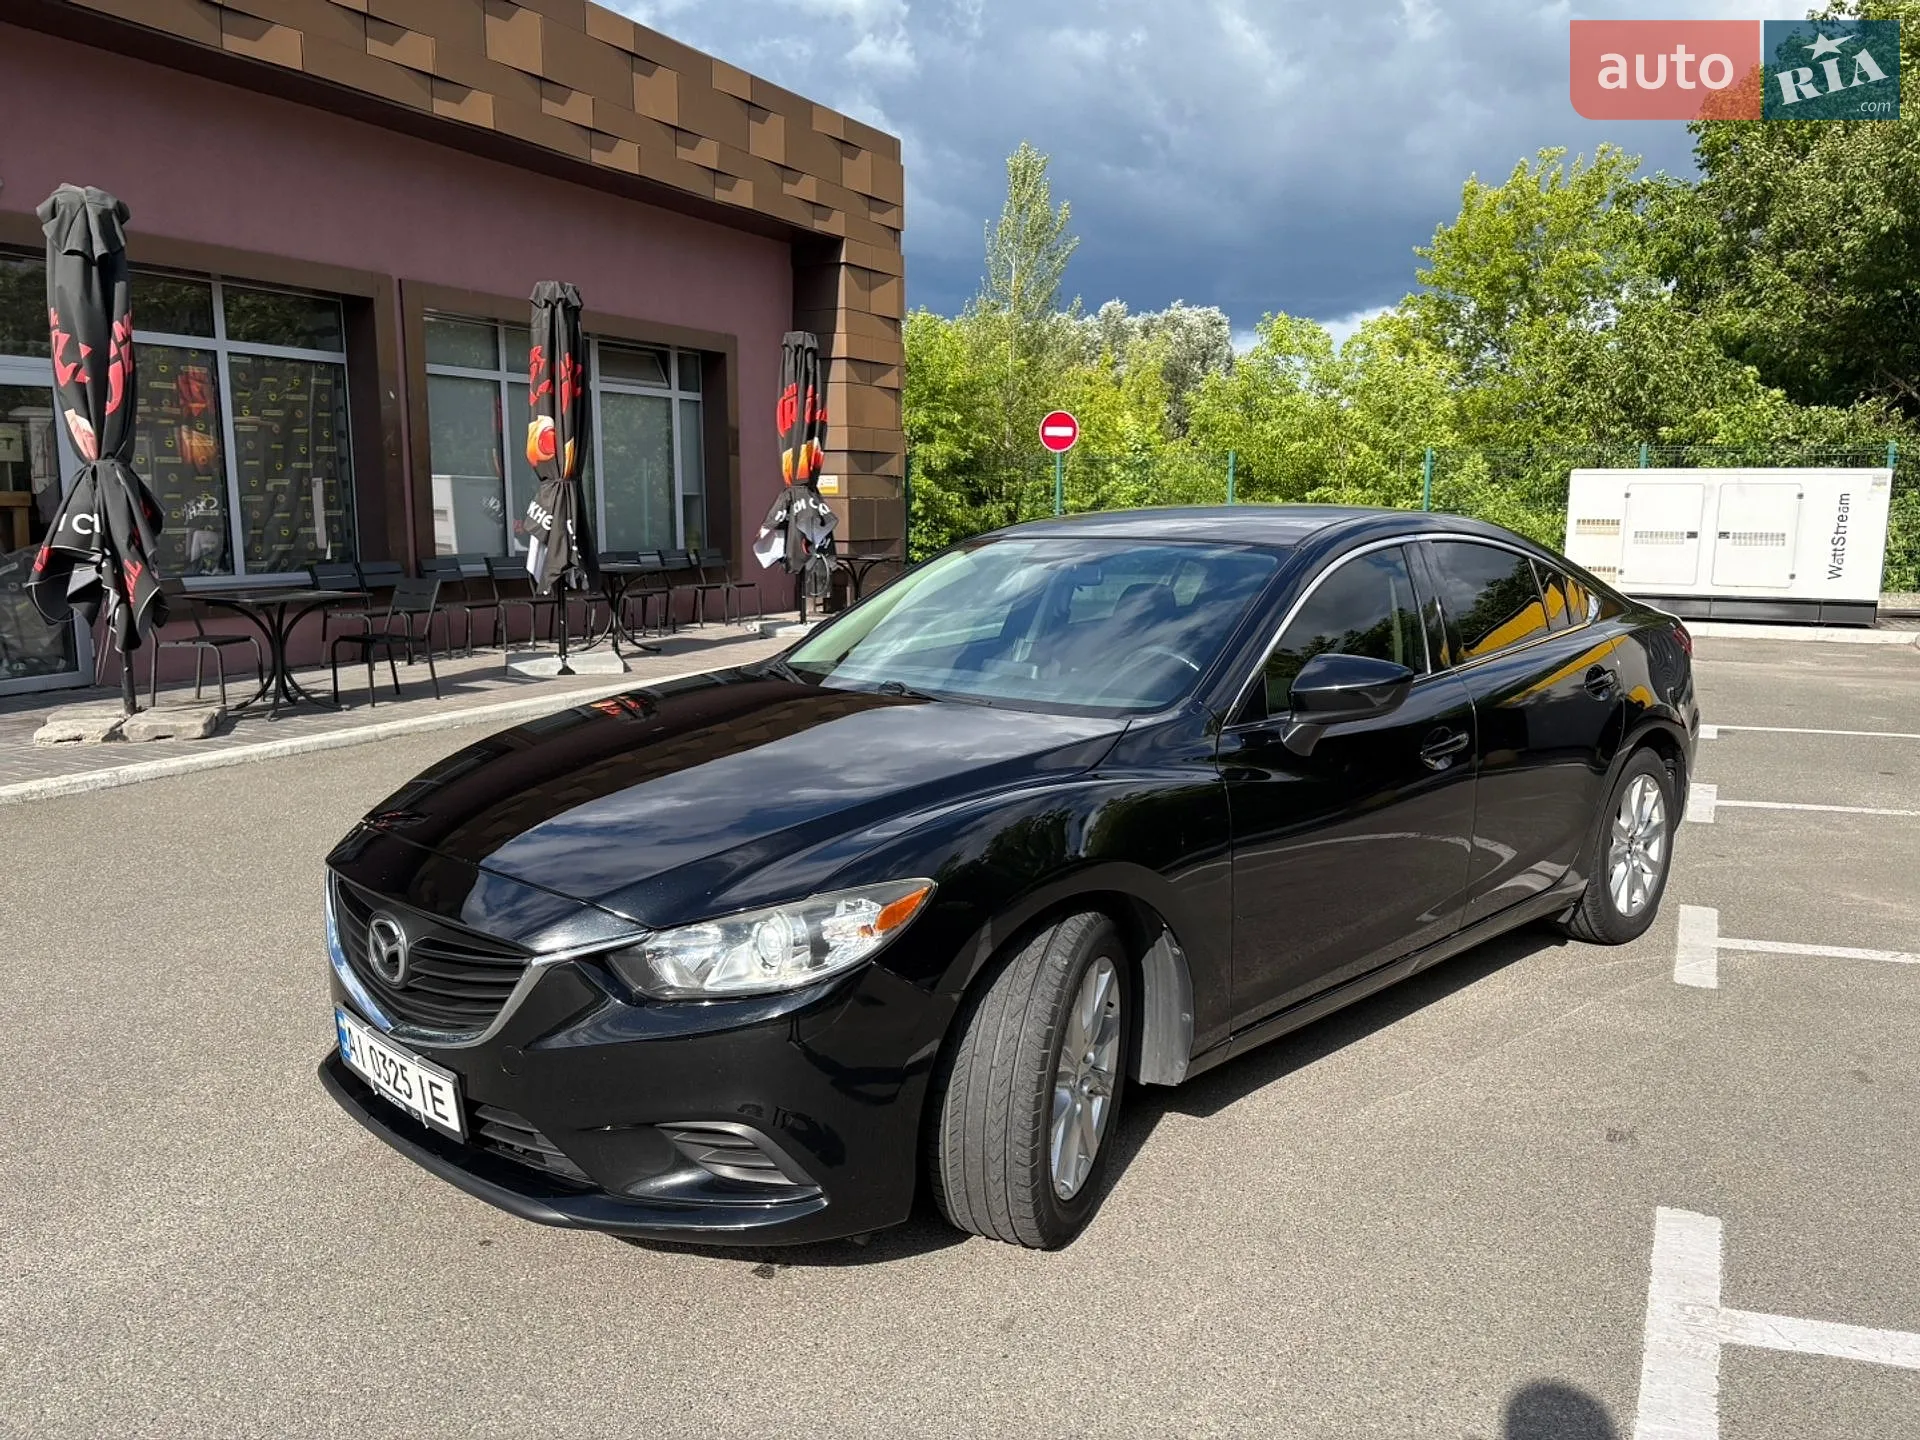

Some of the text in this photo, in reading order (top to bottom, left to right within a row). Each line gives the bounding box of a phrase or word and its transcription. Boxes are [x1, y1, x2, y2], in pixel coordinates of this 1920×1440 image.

[1826, 492, 1851, 580] WattStream
[347, 1026, 366, 1069] AI
[369, 1044, 413, 1100] 0325
[419, 1074, 449, 1122] IE
